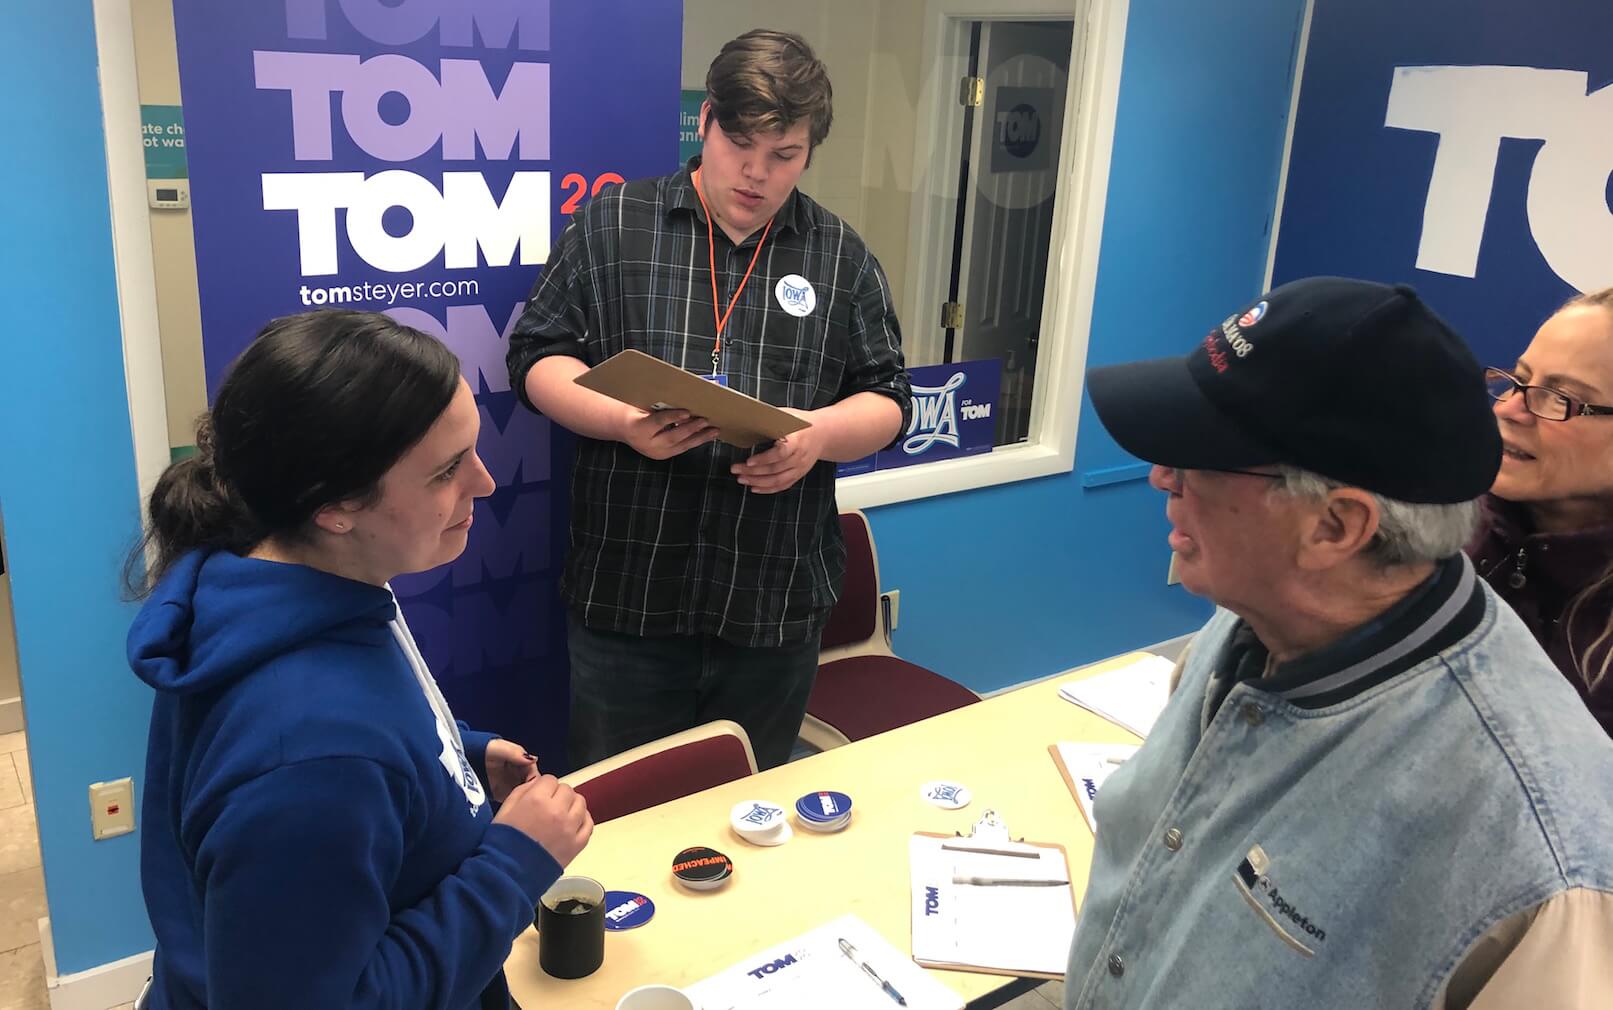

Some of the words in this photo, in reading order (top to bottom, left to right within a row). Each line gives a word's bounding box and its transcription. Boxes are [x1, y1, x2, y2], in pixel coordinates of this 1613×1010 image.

[253, 50, 551, 161] TOM
[261, 169, 551, 276] TOM
[300, 277, 479, 306] tomsteyer.com
[961, 403, 991, 420] TOM
[672, 856, 727, 872] IMPEACHED
[604, 900, 640, 921] TOM
[925, 886, 939, 916] TOM
[1268, 888, 1326, 941] Appleton
[747, 953, 797, 979] TOM
